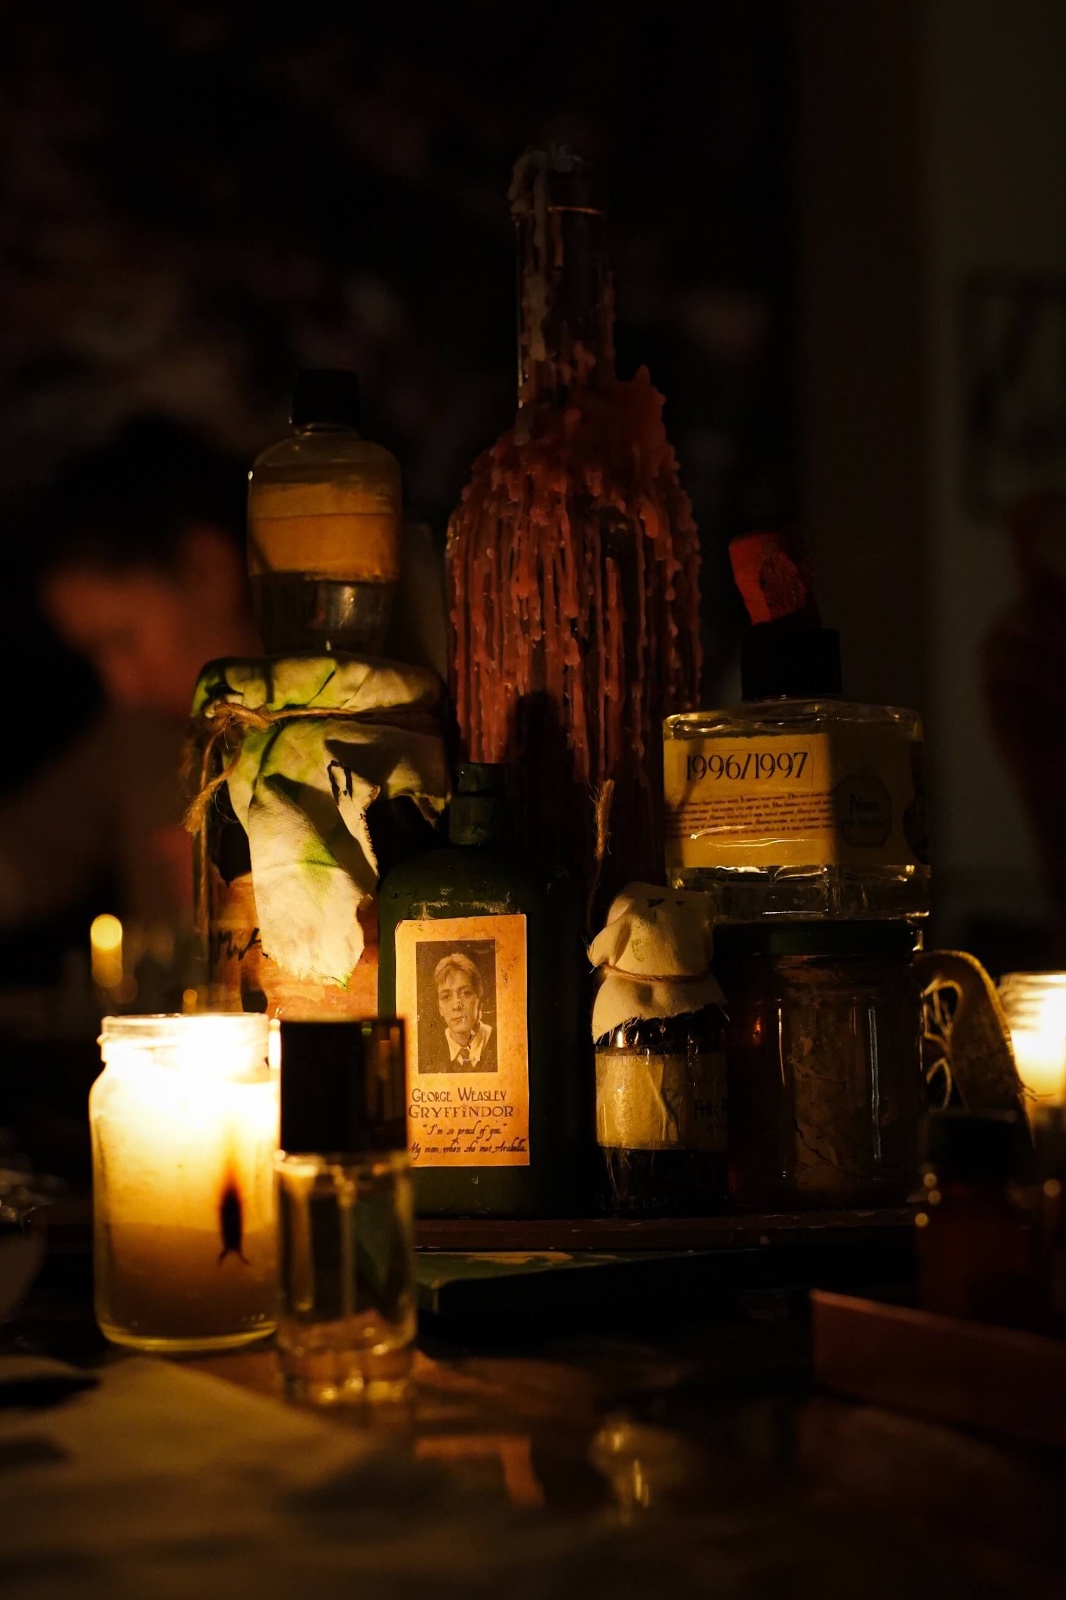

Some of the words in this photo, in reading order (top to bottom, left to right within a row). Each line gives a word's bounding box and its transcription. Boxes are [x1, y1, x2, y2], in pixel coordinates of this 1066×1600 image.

[687, 752, 808, 781] 1996/1997
[411, 1088, 453, 1102] GEORGE
[457, 1087, 507, 1102] WEASLEY
[453, 1120, 482, 1142] proud
[476, 1124, 489, 1140] of
